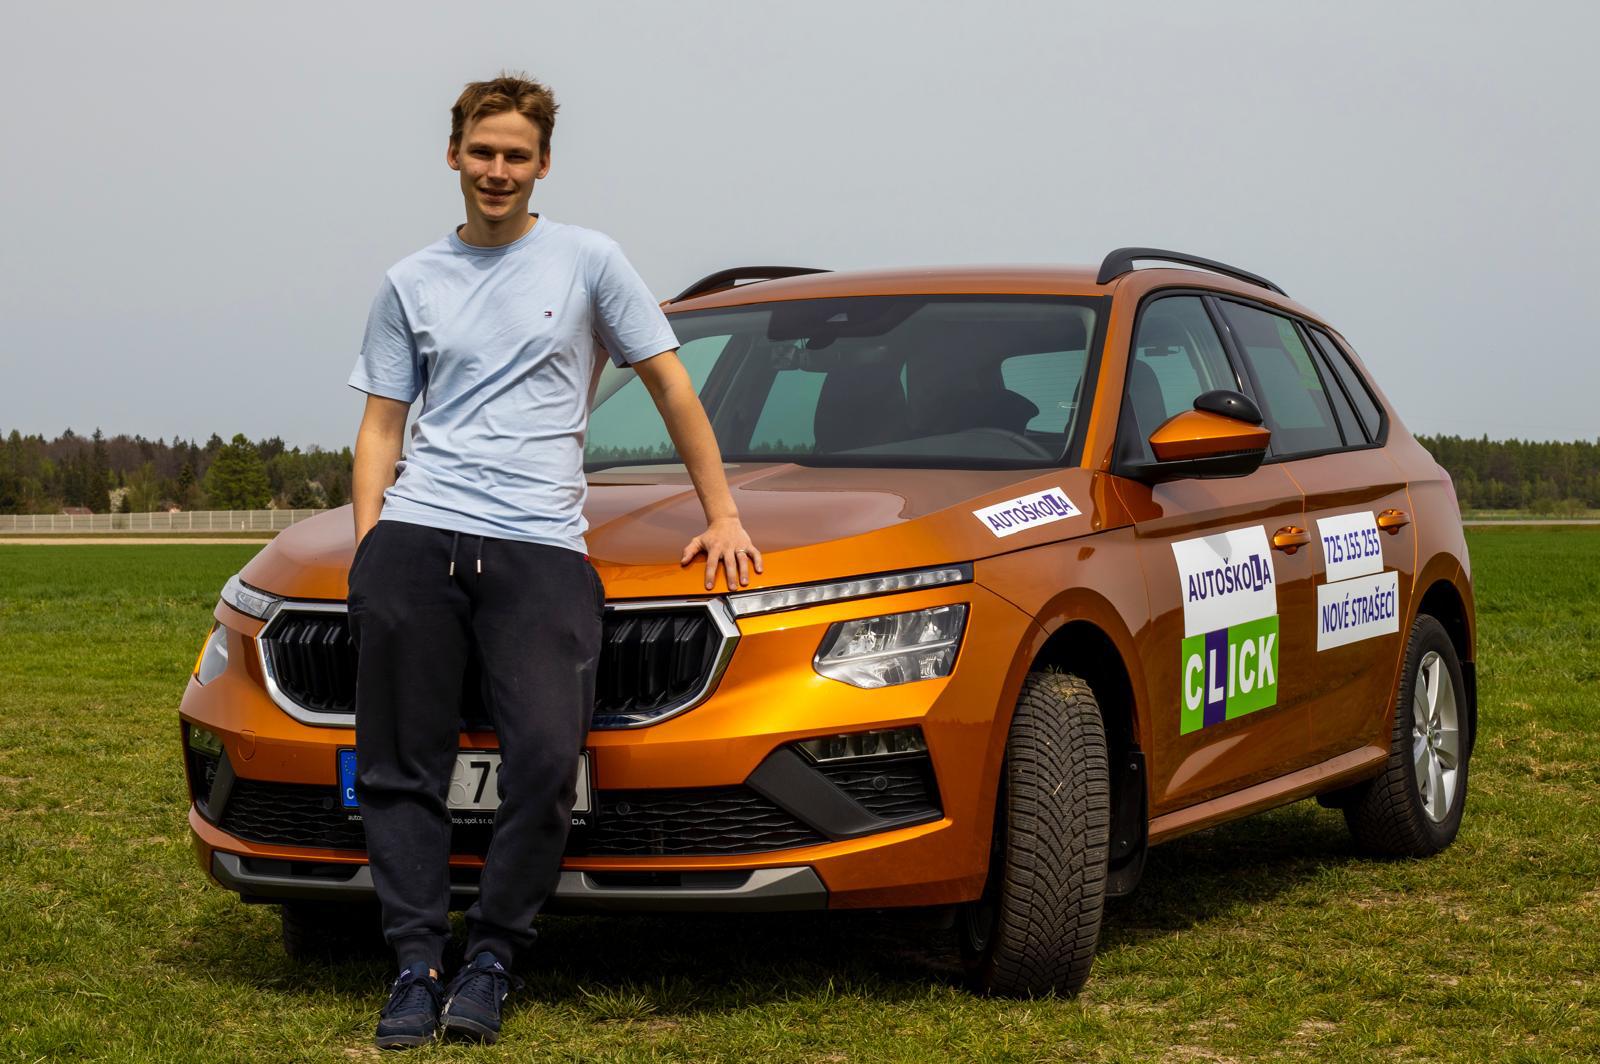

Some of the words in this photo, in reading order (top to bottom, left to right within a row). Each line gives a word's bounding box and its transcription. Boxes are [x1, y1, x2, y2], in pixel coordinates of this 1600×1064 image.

[987, 494, 1073, 531] AUTOŠKOLA
[1324, 535, 1344, 564] 725
[1343, 530, 1362, 560] 155
[1361, 528, 1380, 557] 255
[1188, 554, 1272, 602] AUTOŠKOLA
[1322, 592, 1349, 634] NOVÉ
[1351, 583, 1396, 627] STRAŠECÍ
[1185, 632, 1276, 711] CLICK
[346, 787, 355, 800] C
[470, 761, 502, 803] 7
